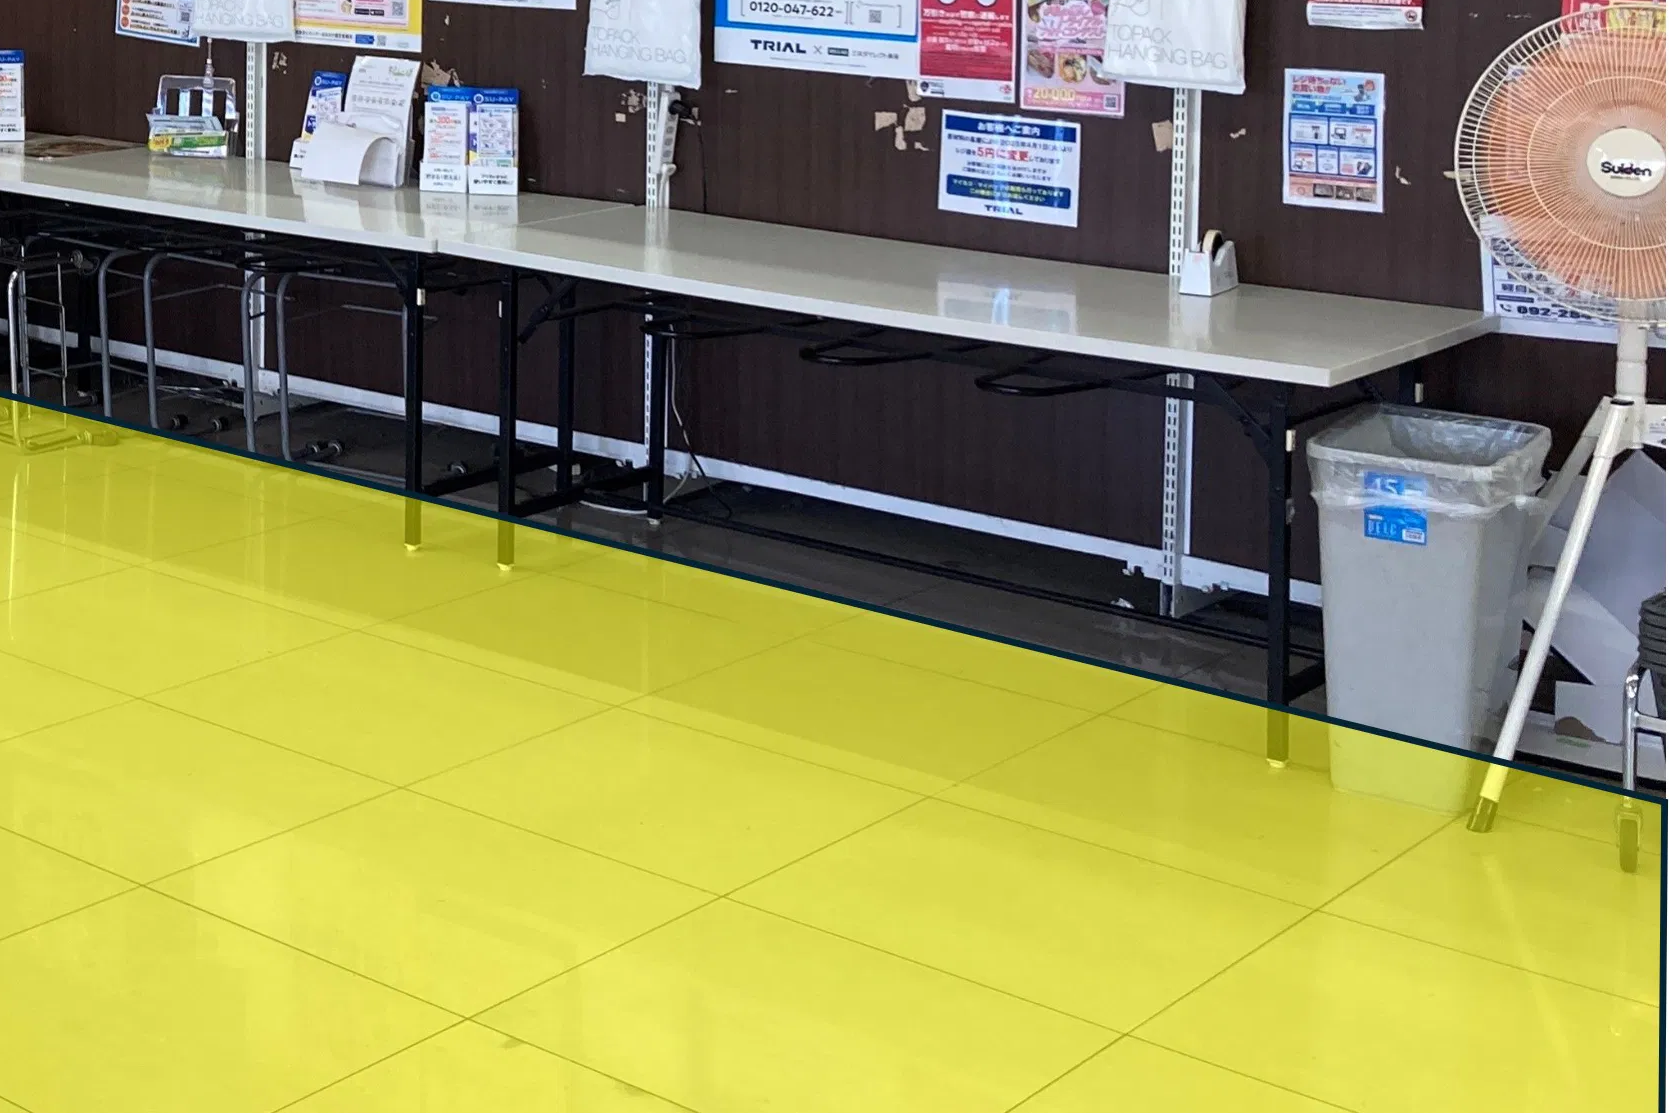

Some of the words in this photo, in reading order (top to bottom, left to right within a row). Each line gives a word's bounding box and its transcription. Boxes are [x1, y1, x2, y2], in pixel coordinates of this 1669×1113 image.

[749, 1, 834, 17] 0120-047-622
[1111, 24, 1173, 46] TOPACK
[592, 44, 652, 62] HANGING
[655, 47, 687, 64] BAG
[750, 39, 807, 54] TRIAL
[1108, 45, 1188, 67] HANGING
[1191, 48, 1228, 70] BAG
[1600, 160, 1653, 177] Suiden
[984, 204, 1023, 216] TRIAL
